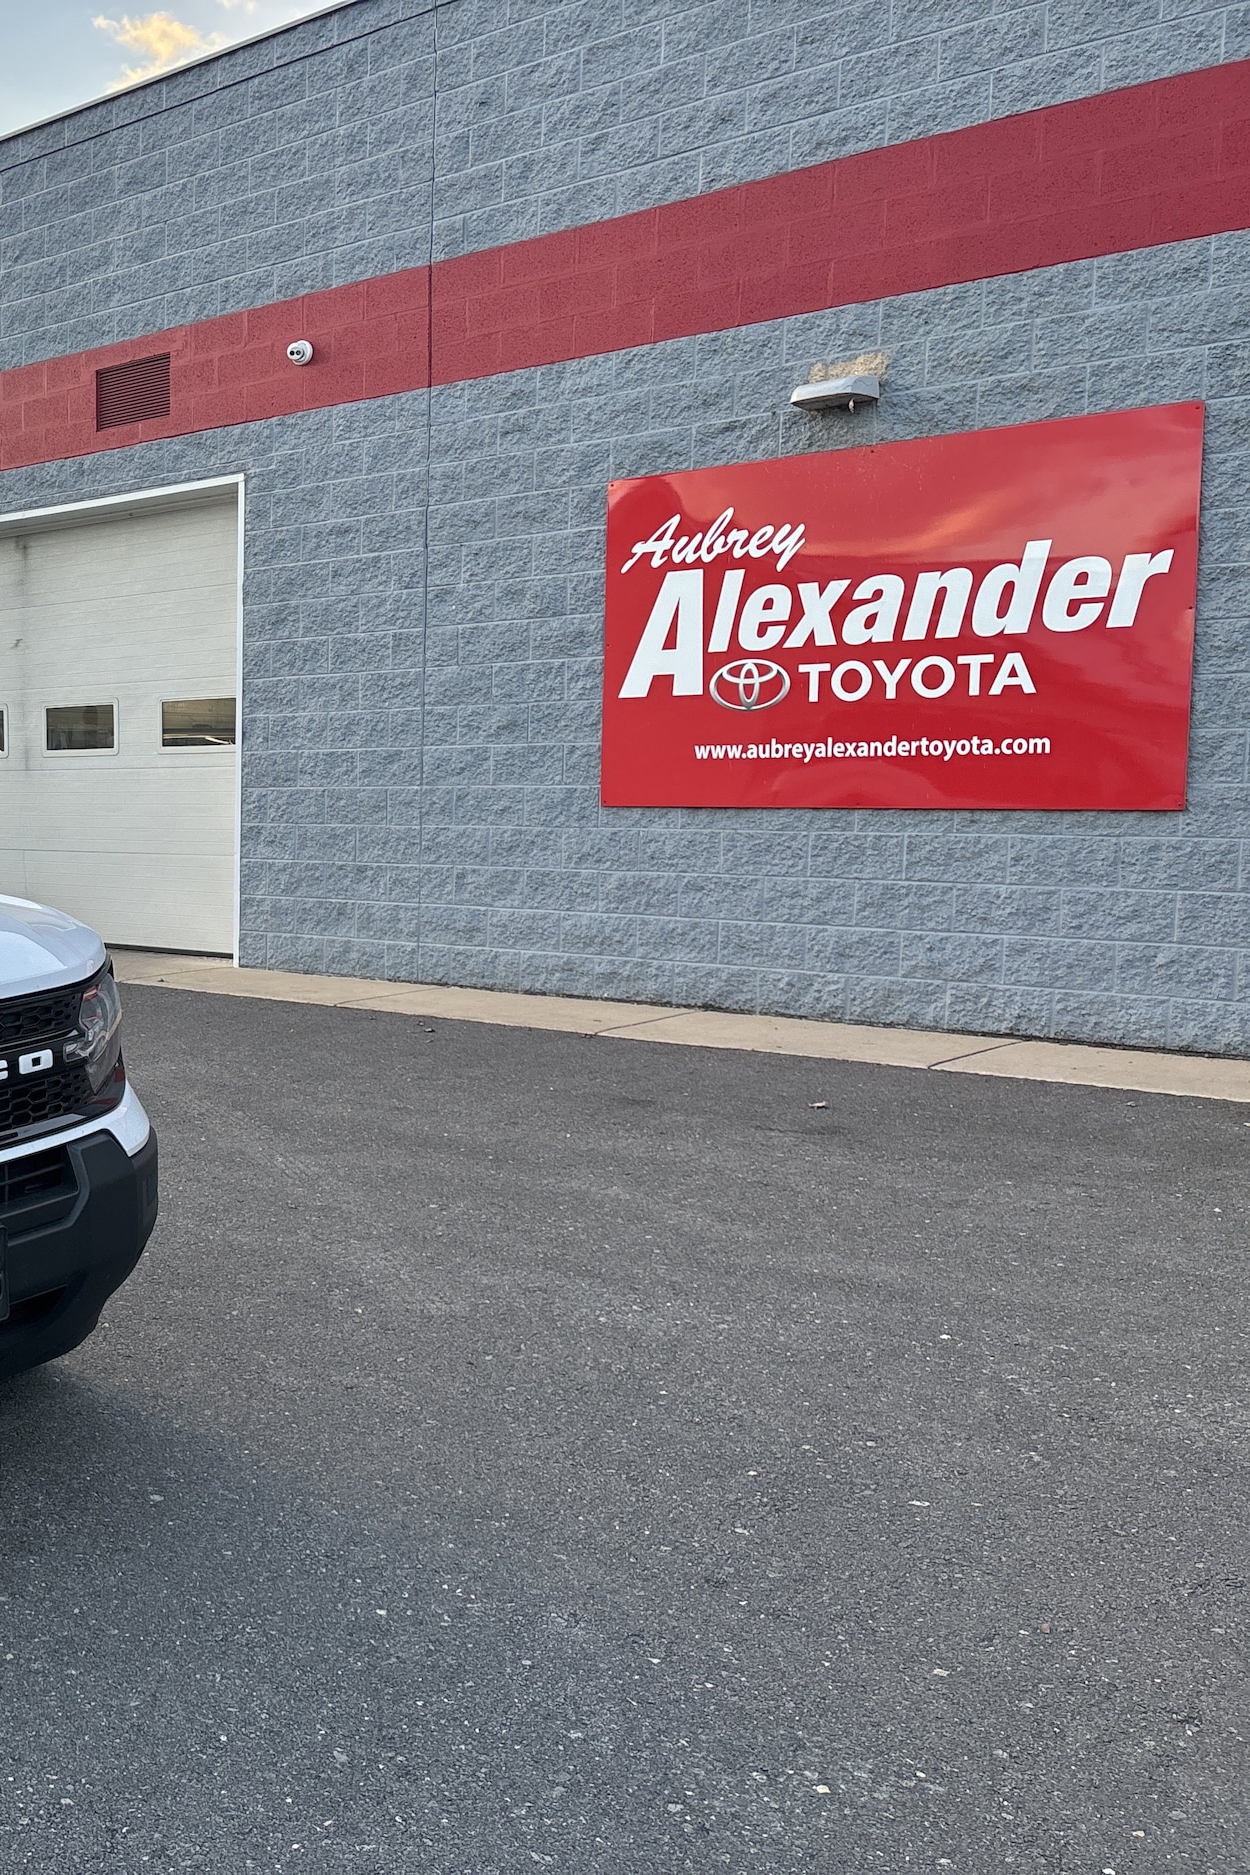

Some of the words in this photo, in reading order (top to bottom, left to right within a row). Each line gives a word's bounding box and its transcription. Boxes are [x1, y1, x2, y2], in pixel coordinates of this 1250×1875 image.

[621, 507, 806, 573] Aubrey
[618, 539, 1175, 698] Alexander
[799, 653, 1037, 702] TOYOTA
[694, 735, 1051, 763] www.aubreyalexandertoyota.com
